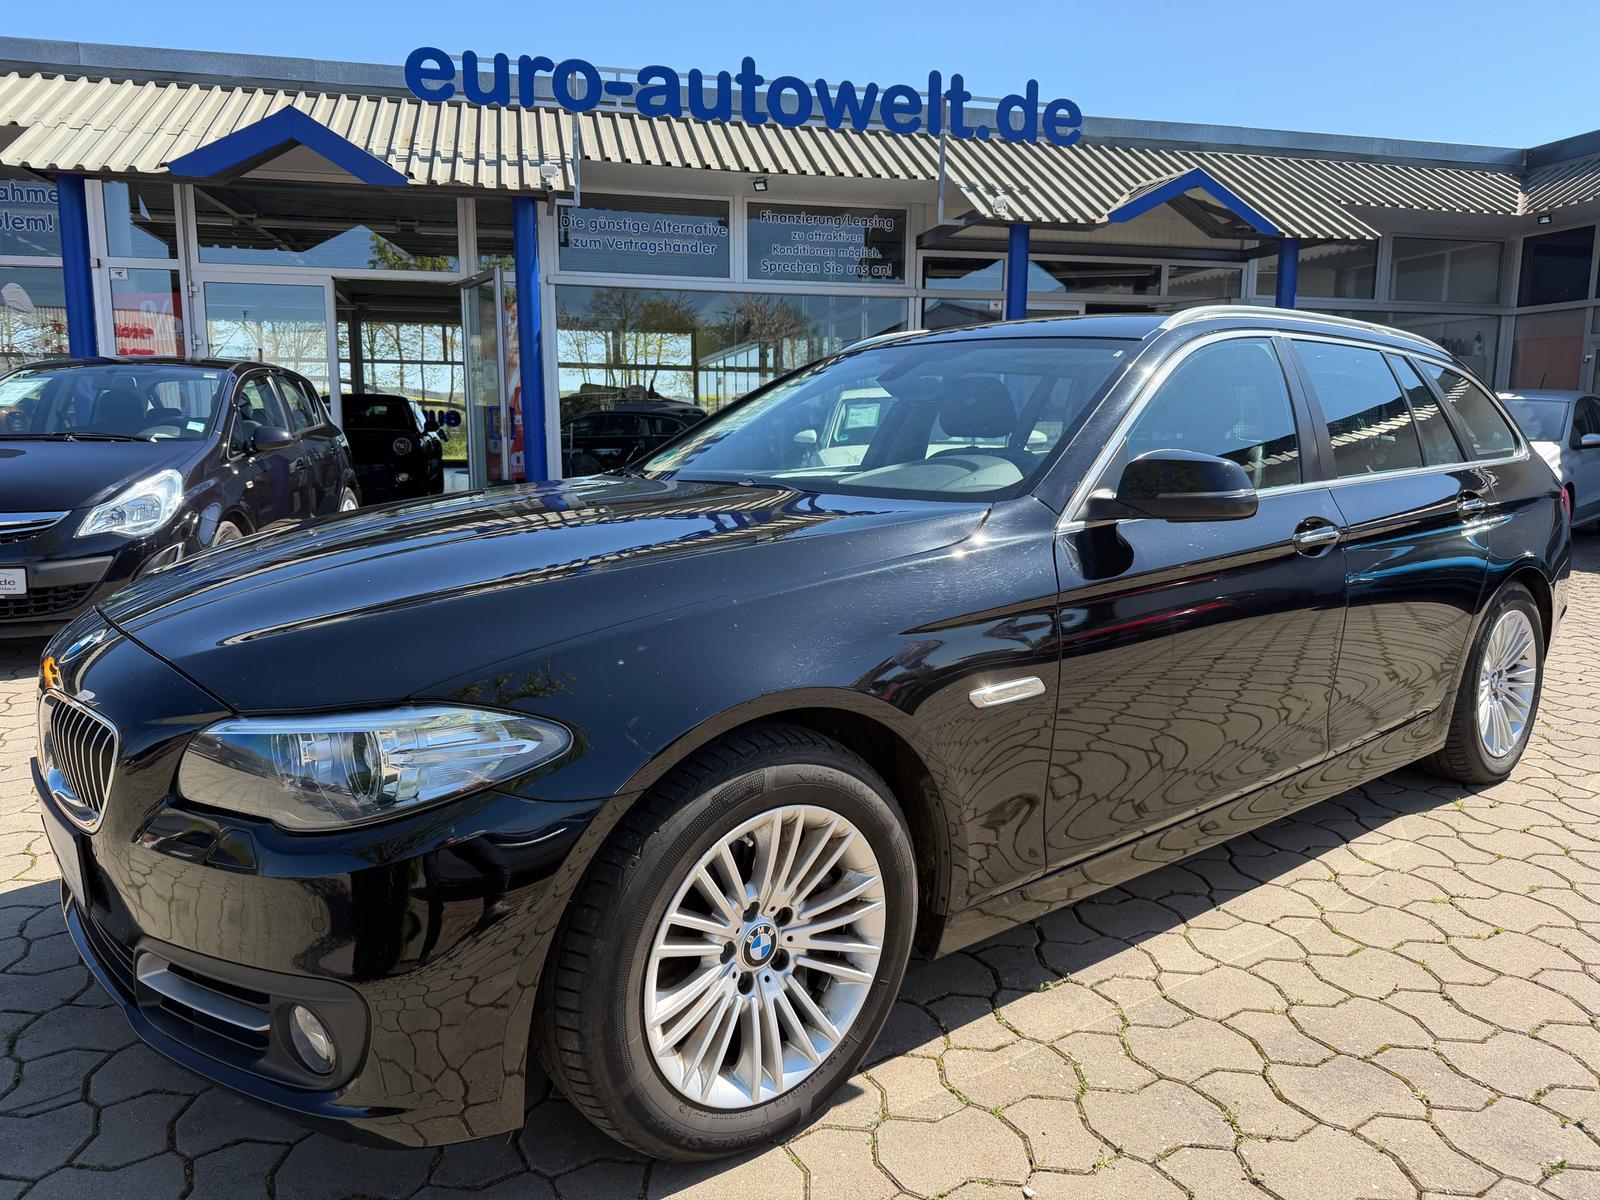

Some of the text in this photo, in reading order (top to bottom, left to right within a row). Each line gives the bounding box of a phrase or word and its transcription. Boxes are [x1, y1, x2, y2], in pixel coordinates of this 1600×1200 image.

[404, 46, 1082, 147] euro-autowelt.de
[0, 210, 54, 232] lem!
[561, 214, 728, 237] Die günstige Alternative
[760, 210, 894, 232] Finanzierung/Leasing
[791, 230, 865, 243] zu attraktiven
[572, 237, 718, 255] zum Vertragshändler
[772, 244, 882, 260] Konditionen möglich.
[760, 259, 892, 276] Sprechen Sie uns an!
[746, 925, 775, 943] BMW
